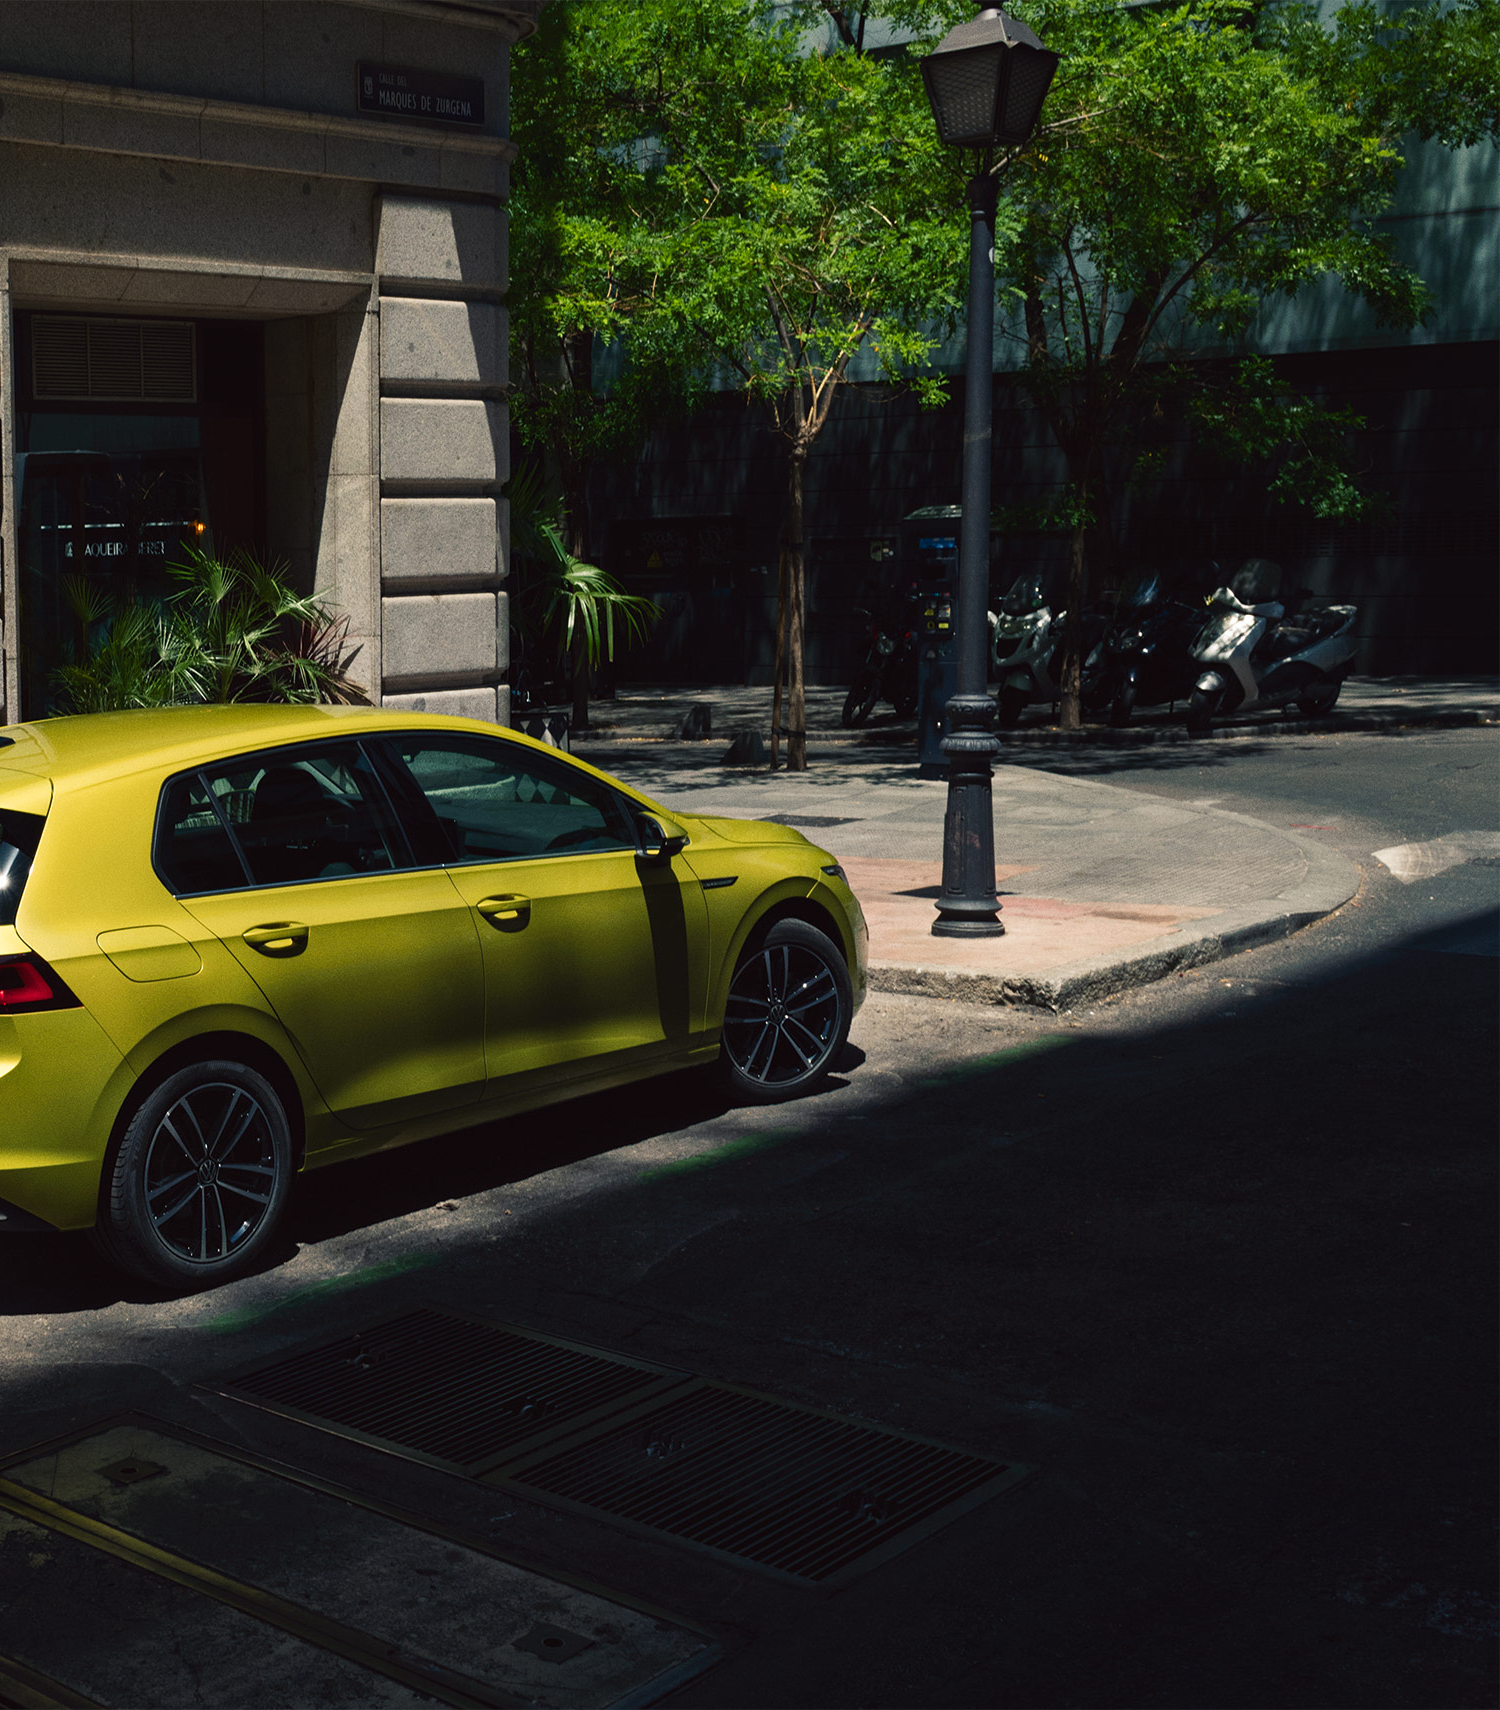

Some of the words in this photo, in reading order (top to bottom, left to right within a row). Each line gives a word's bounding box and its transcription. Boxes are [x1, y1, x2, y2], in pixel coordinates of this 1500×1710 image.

[379, 73, 394, 85] CALLE
[379, 90, 417, 110] MARQUES
[420, 96, 431, 111] DE
[436, 98, 472, 117] ZURGENA
[84, 541, 128, 557] AQUEIRA
